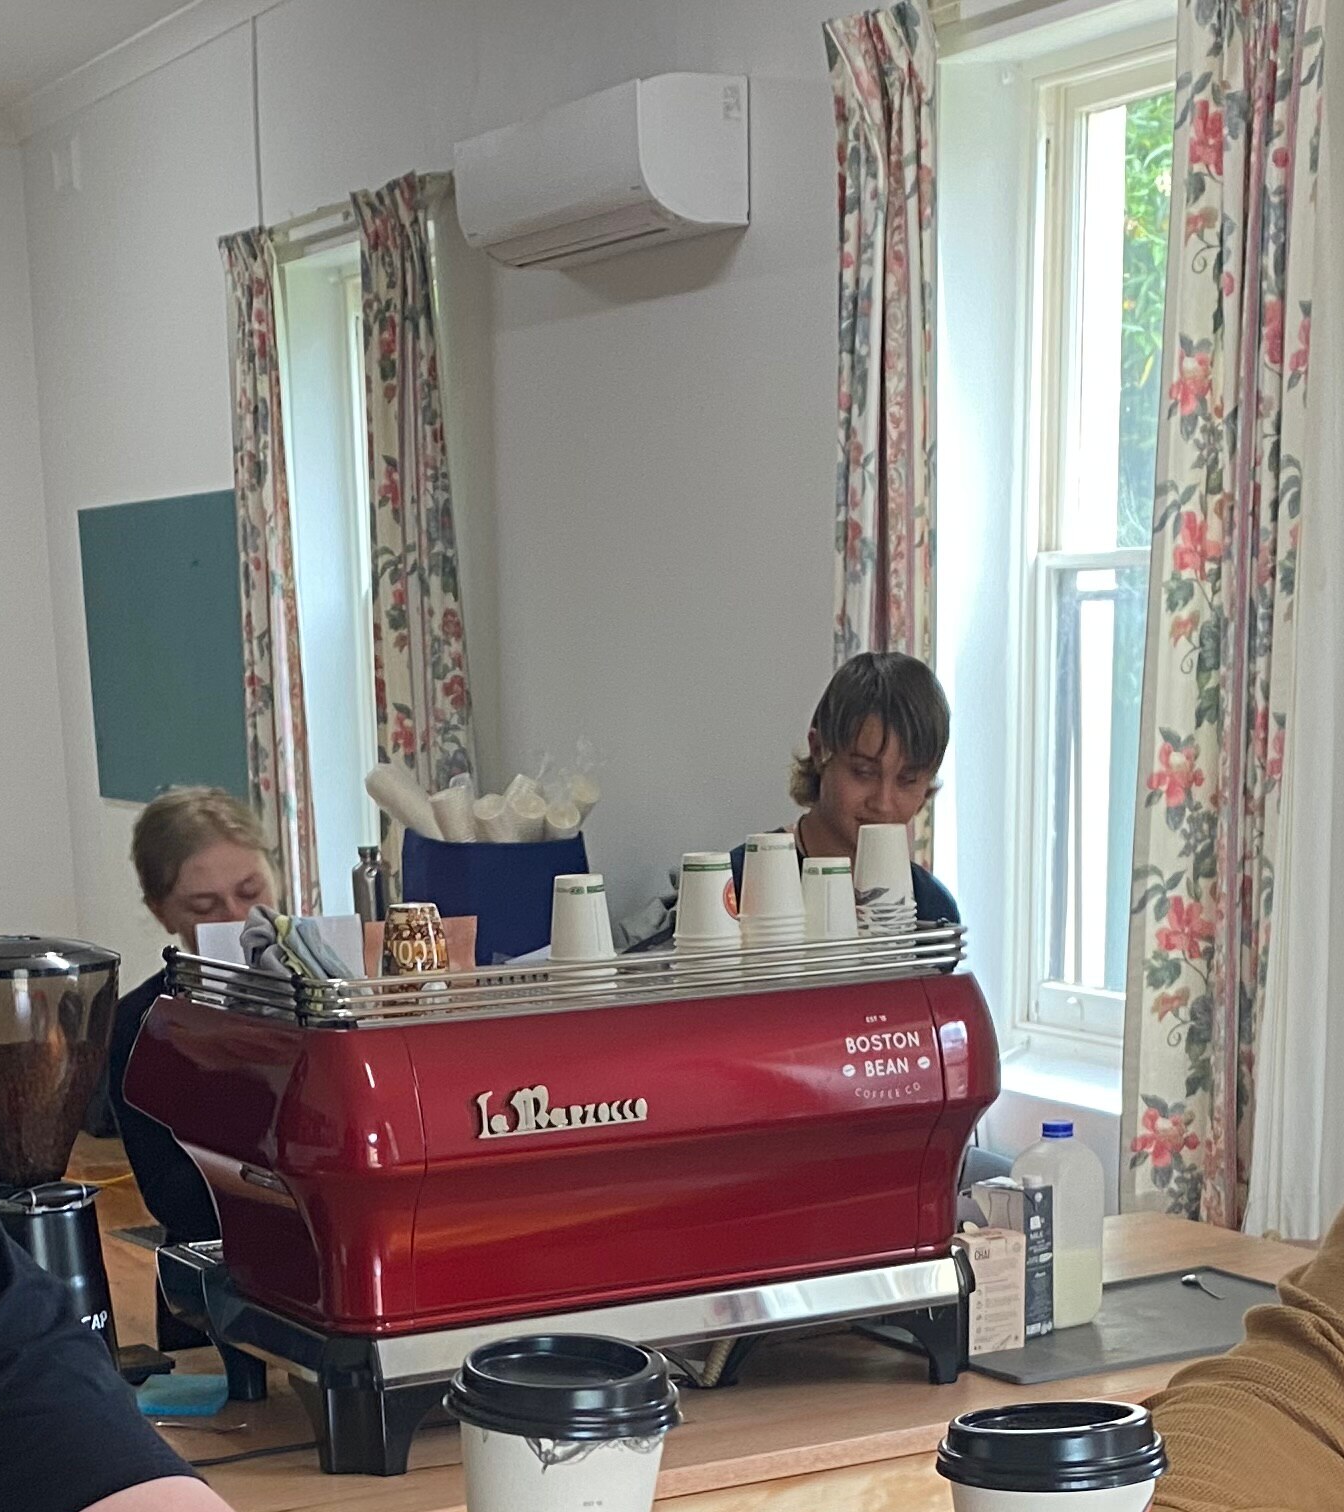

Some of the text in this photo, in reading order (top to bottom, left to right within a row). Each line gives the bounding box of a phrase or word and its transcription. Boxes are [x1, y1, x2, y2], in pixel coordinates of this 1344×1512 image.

[845, 1030, 920, 1054] BOSTON
[864, 1057, 910, 1077] BEAN
[854, 1081, 921, 1099] COFFEE CO
